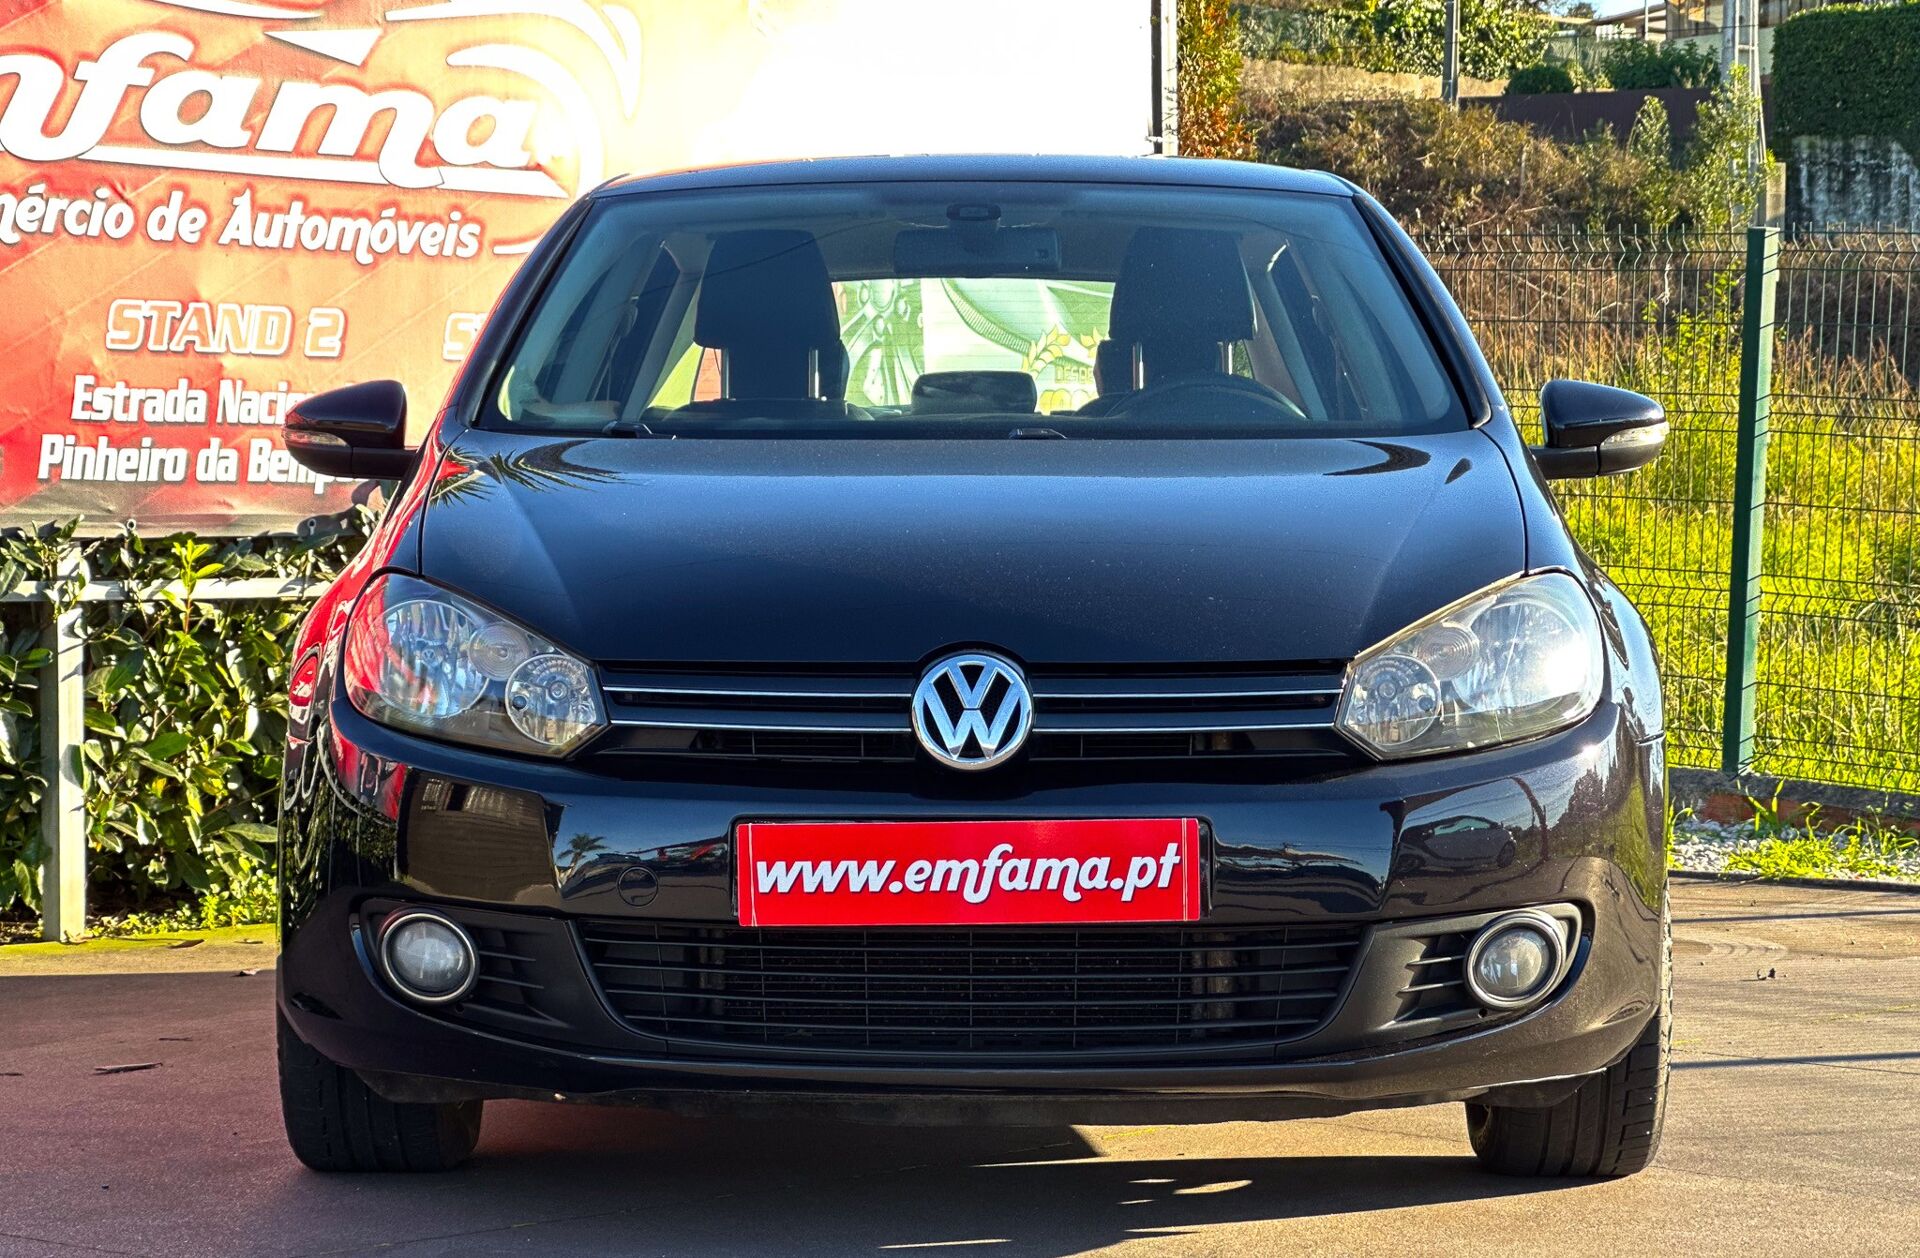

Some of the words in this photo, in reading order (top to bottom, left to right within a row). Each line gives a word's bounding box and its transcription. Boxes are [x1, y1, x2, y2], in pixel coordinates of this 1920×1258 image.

[146, 190, 208, 244] de
[218, 188, 482, 265] Automóveis
[106, 299, 293, 356] STAND
[304, 307, 347, 358] 2
[442, 312, 489, 361] S
[71, 375, 208, 424] Estrada
[216, 379, 314, 425] Naci
[37, 434, 188, 482] Pinheiro
[196, 437, 240, 483] da
[756, 843, 1181, 903] www.emfama.pt
